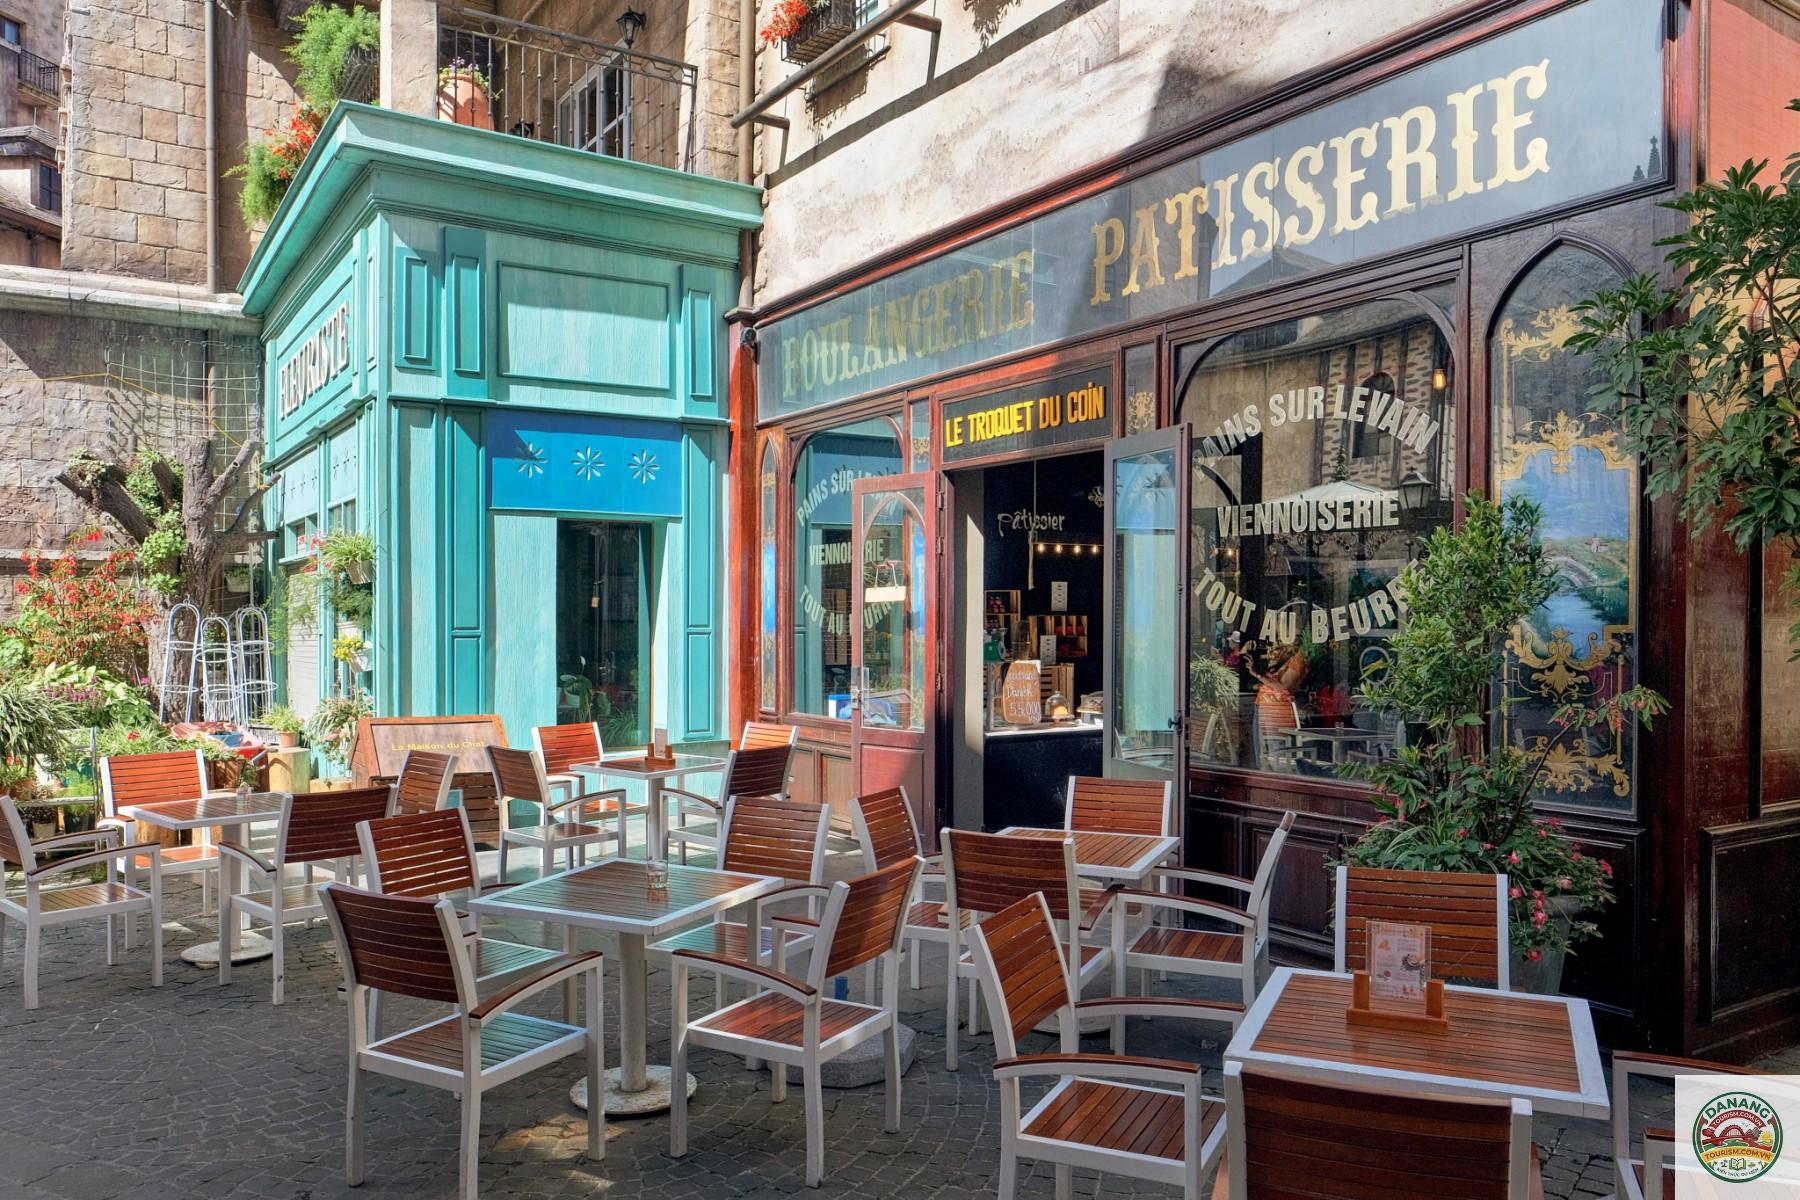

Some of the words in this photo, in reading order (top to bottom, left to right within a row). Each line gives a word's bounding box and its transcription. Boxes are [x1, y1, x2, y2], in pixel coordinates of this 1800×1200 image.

[783, 250, 1034, 398] BOULANGERIE
[1089, 58, 1552, 309] PATISSERIE
[280, 300, 349, 421] FLEURISTE
[945, 415, 964, 448] LE
[967, 400, 1034, 441] TROQUET
[1039, 395, 1061, 430] DU
[1269, 385, 1325, 428] SUR
[1334, 384, 1439, 455] LEVAIN
[797, 479, 828, 526] PAINS
[831, 470, 854, 495] SUR
[997, 508, 1066, 537] Pâtissier
[1217, 495, 1400, 538] VIENNOISERIE
[809, 538, 885, 567] VIENNOIRIE
[799, 585, 827, 627] TOUT
[828, 612, 844, 636] AU
[1194, 567, 1256, 632] TOUT
[1259, 611, 1297, 645] AU
